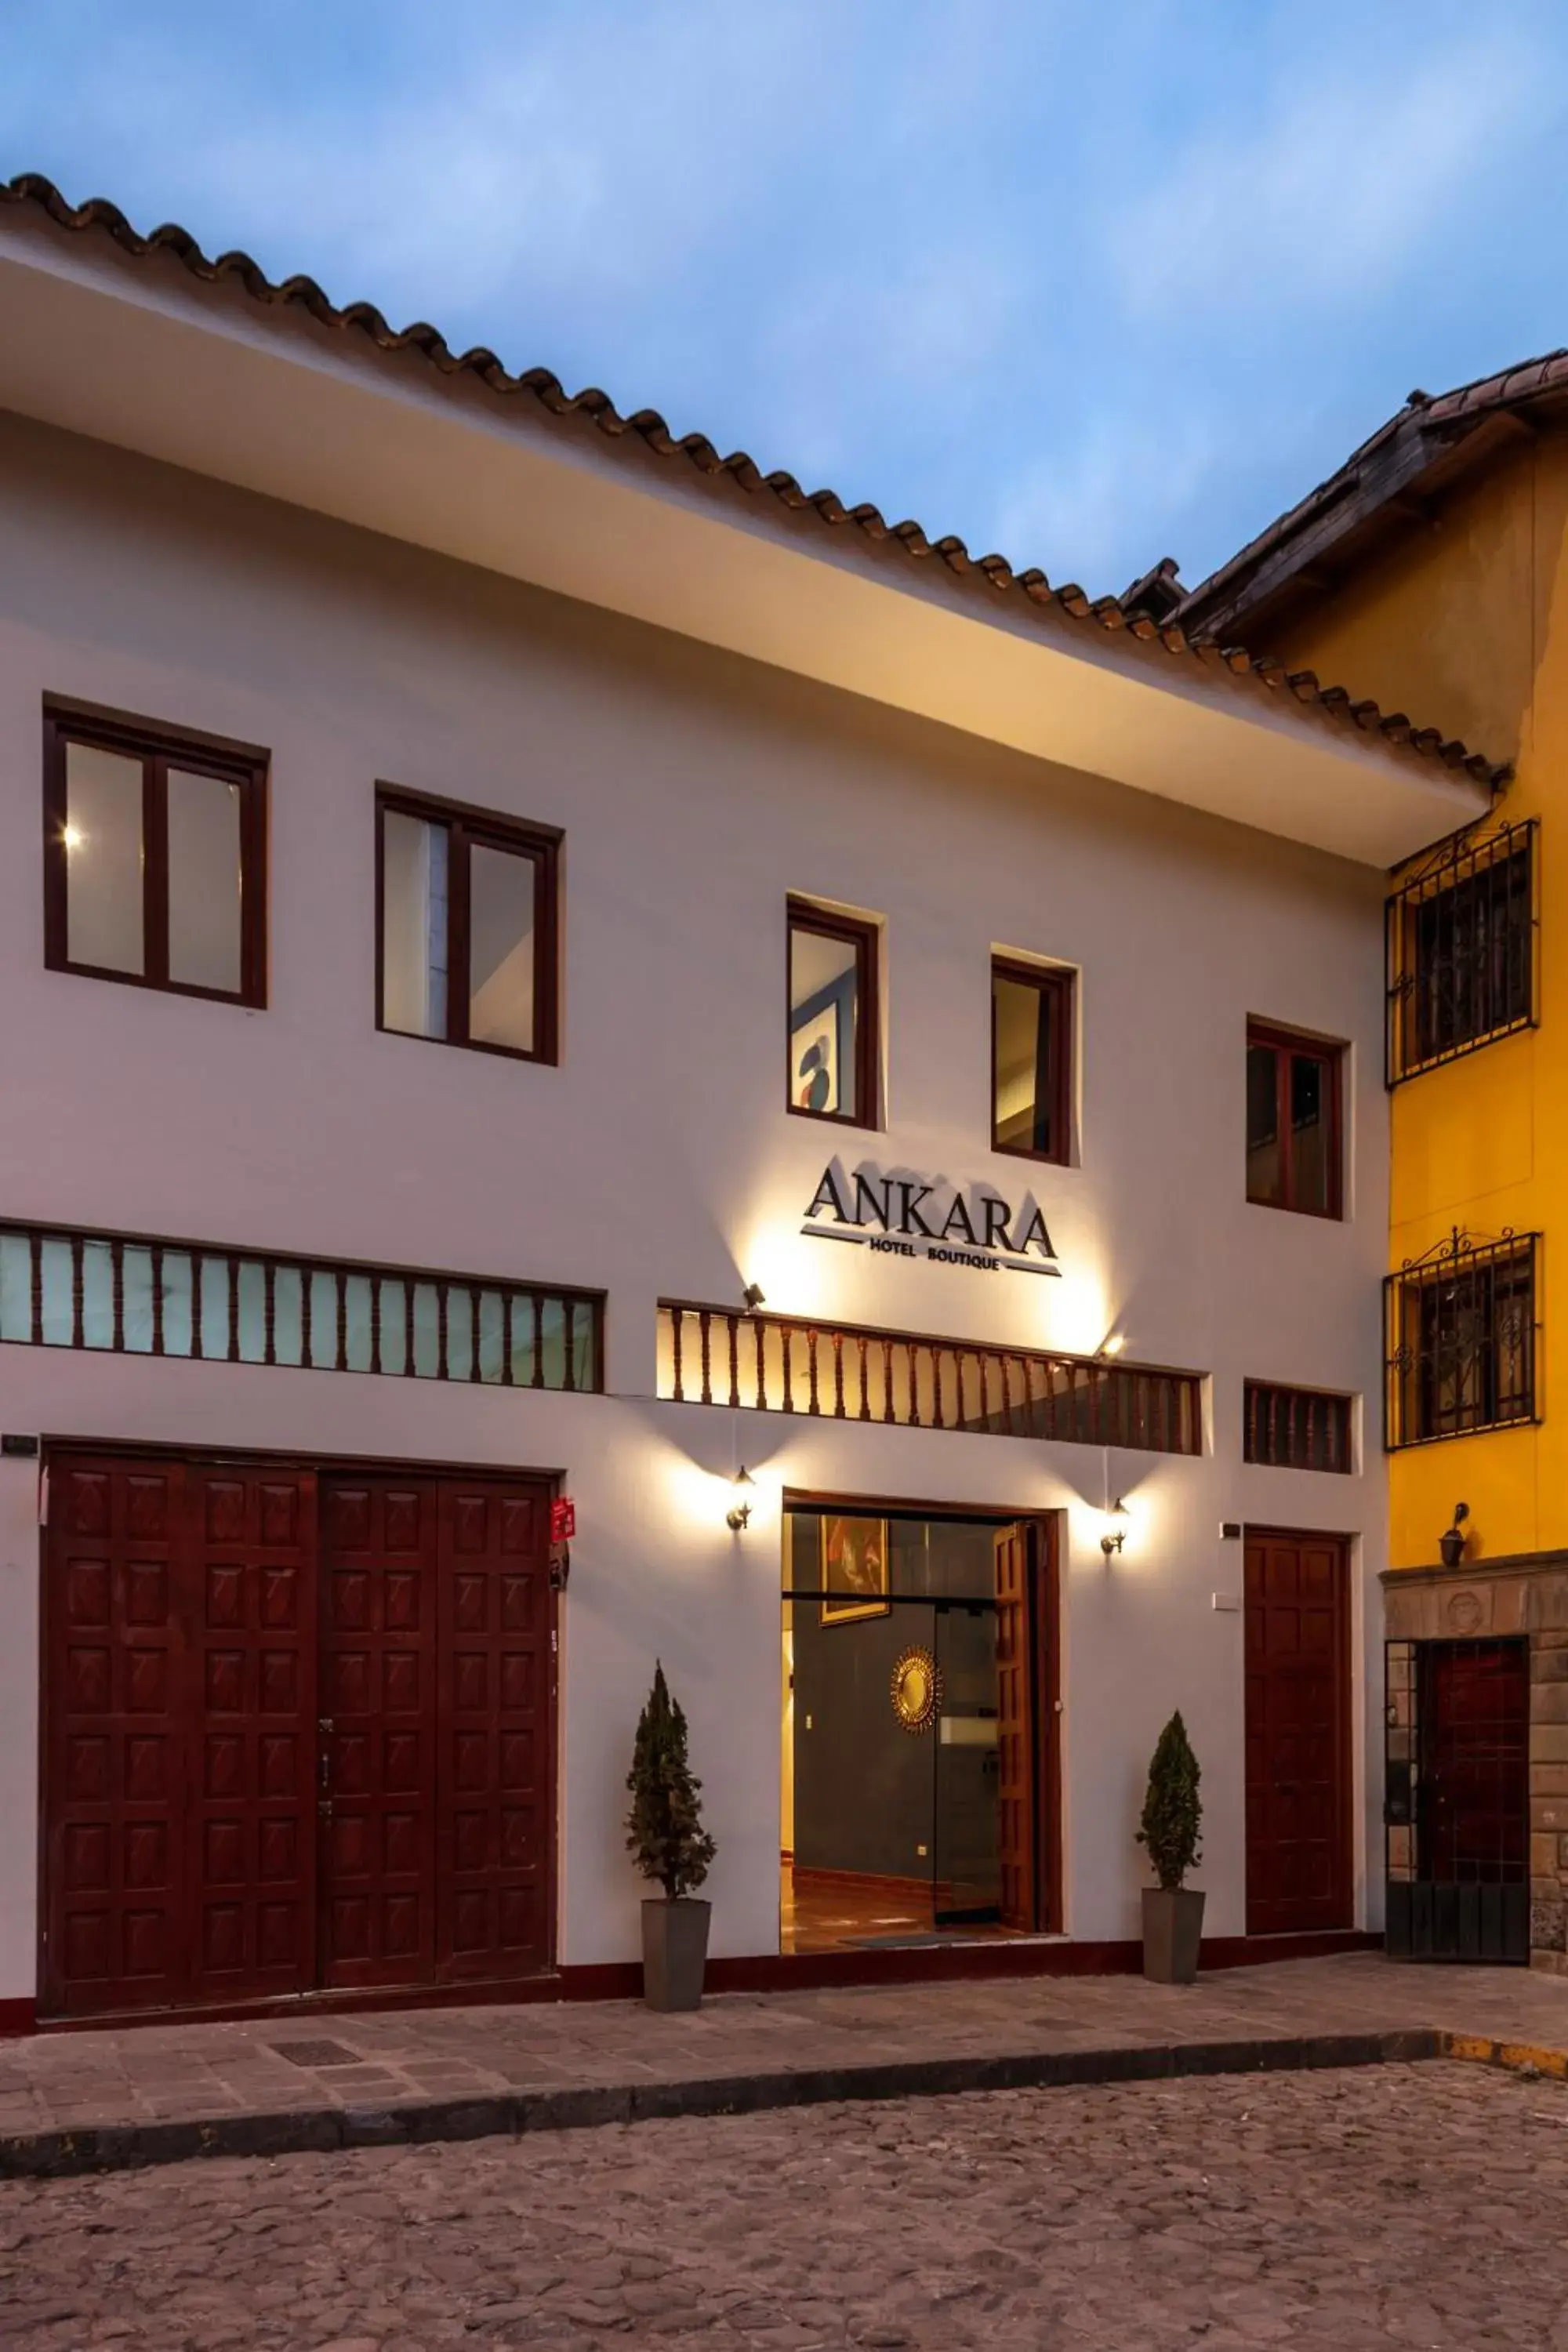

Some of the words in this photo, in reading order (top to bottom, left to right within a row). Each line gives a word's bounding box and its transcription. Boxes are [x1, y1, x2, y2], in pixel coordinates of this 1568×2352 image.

[804, 1167, 1058, 1258] ANKARA
[870, 1238, 916, 1257] HOTEL
[927, 1247, 1000, 1271] BOUTIQUE
